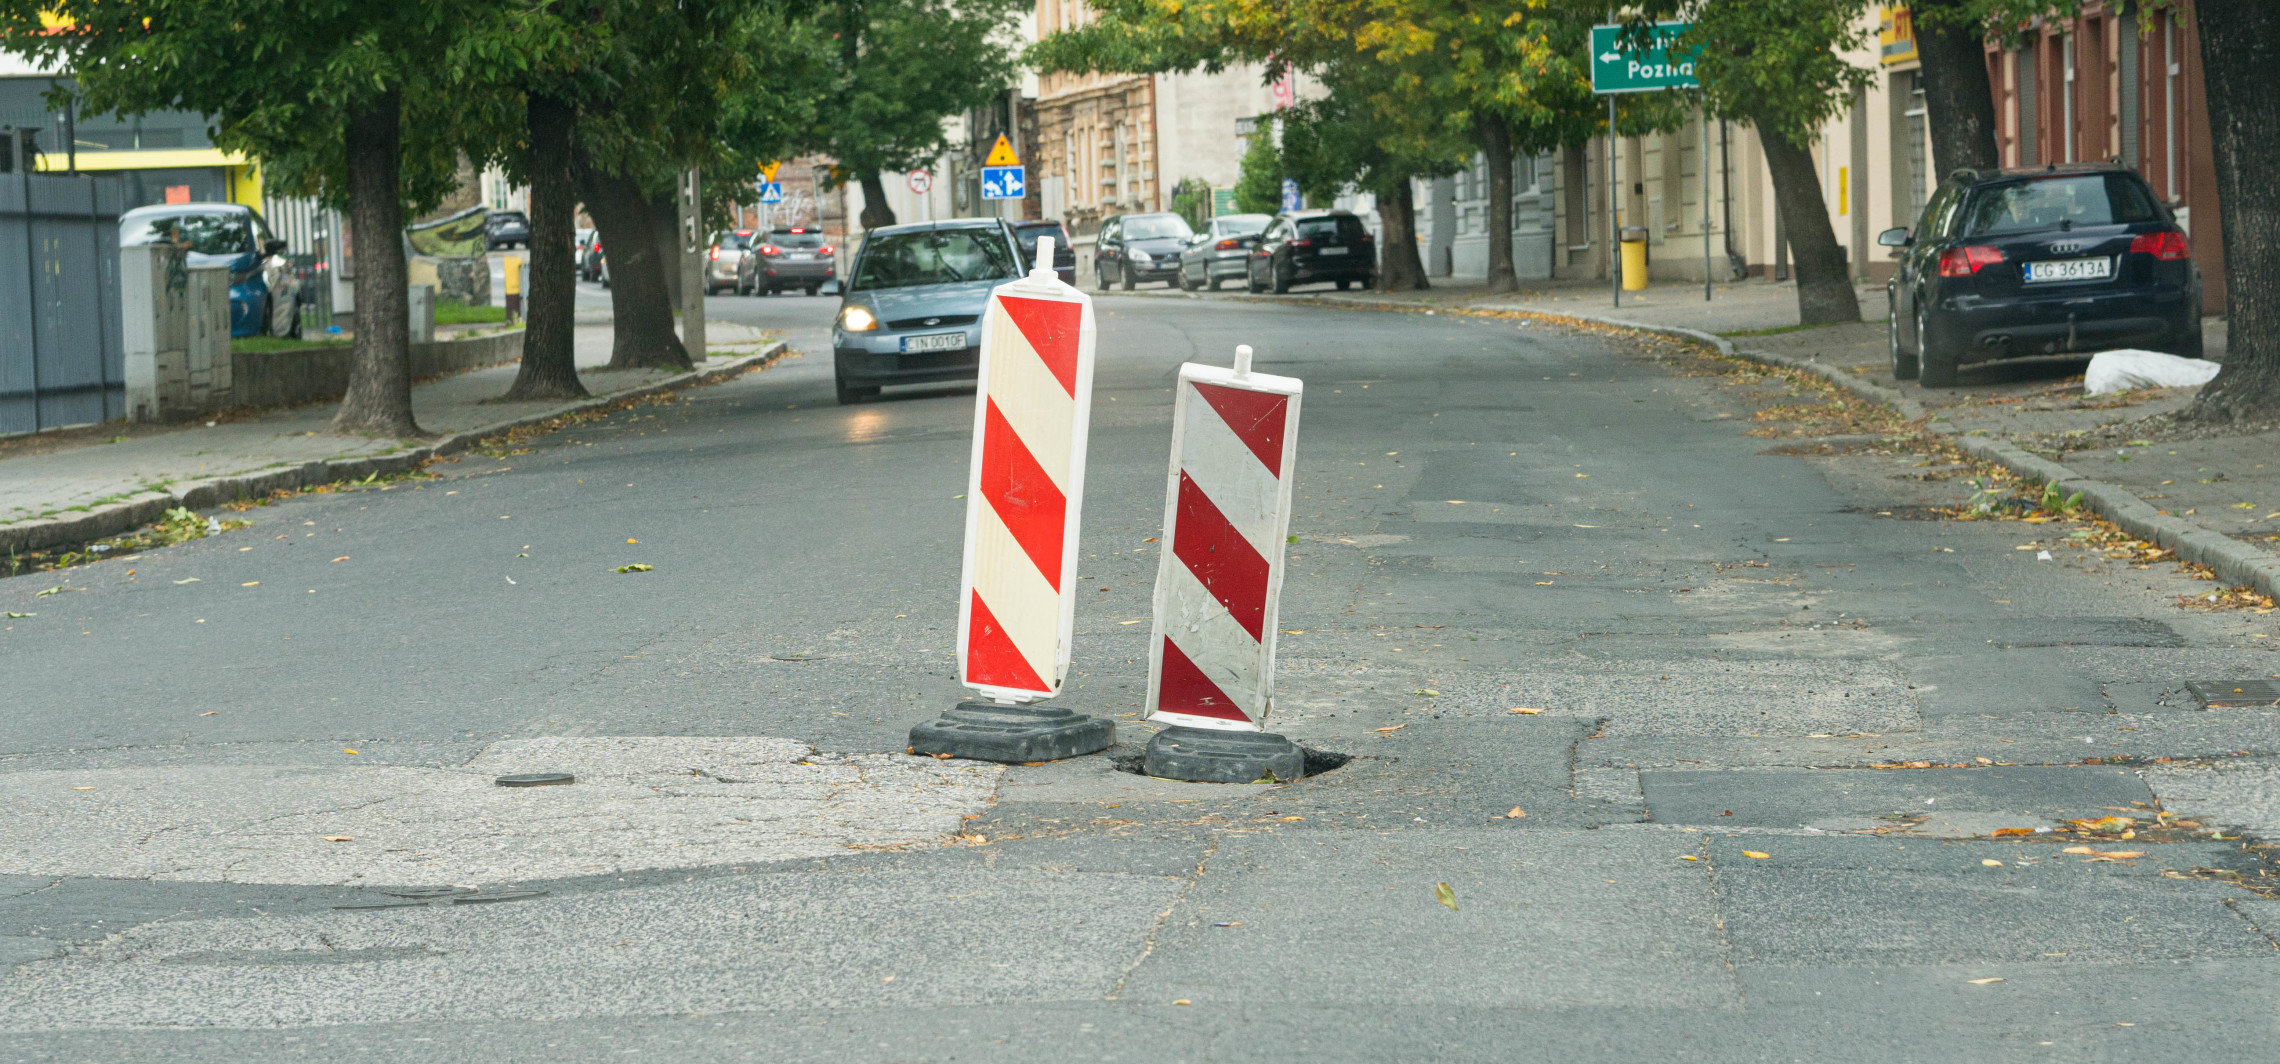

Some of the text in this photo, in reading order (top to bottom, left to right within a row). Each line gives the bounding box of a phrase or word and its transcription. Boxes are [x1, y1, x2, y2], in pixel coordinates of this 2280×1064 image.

[1628, 60, 1697, 79] Pozna
[2034, 261, 2106, 278] CG 3613A
[906, 334, 964, 350] CIN 0010F
